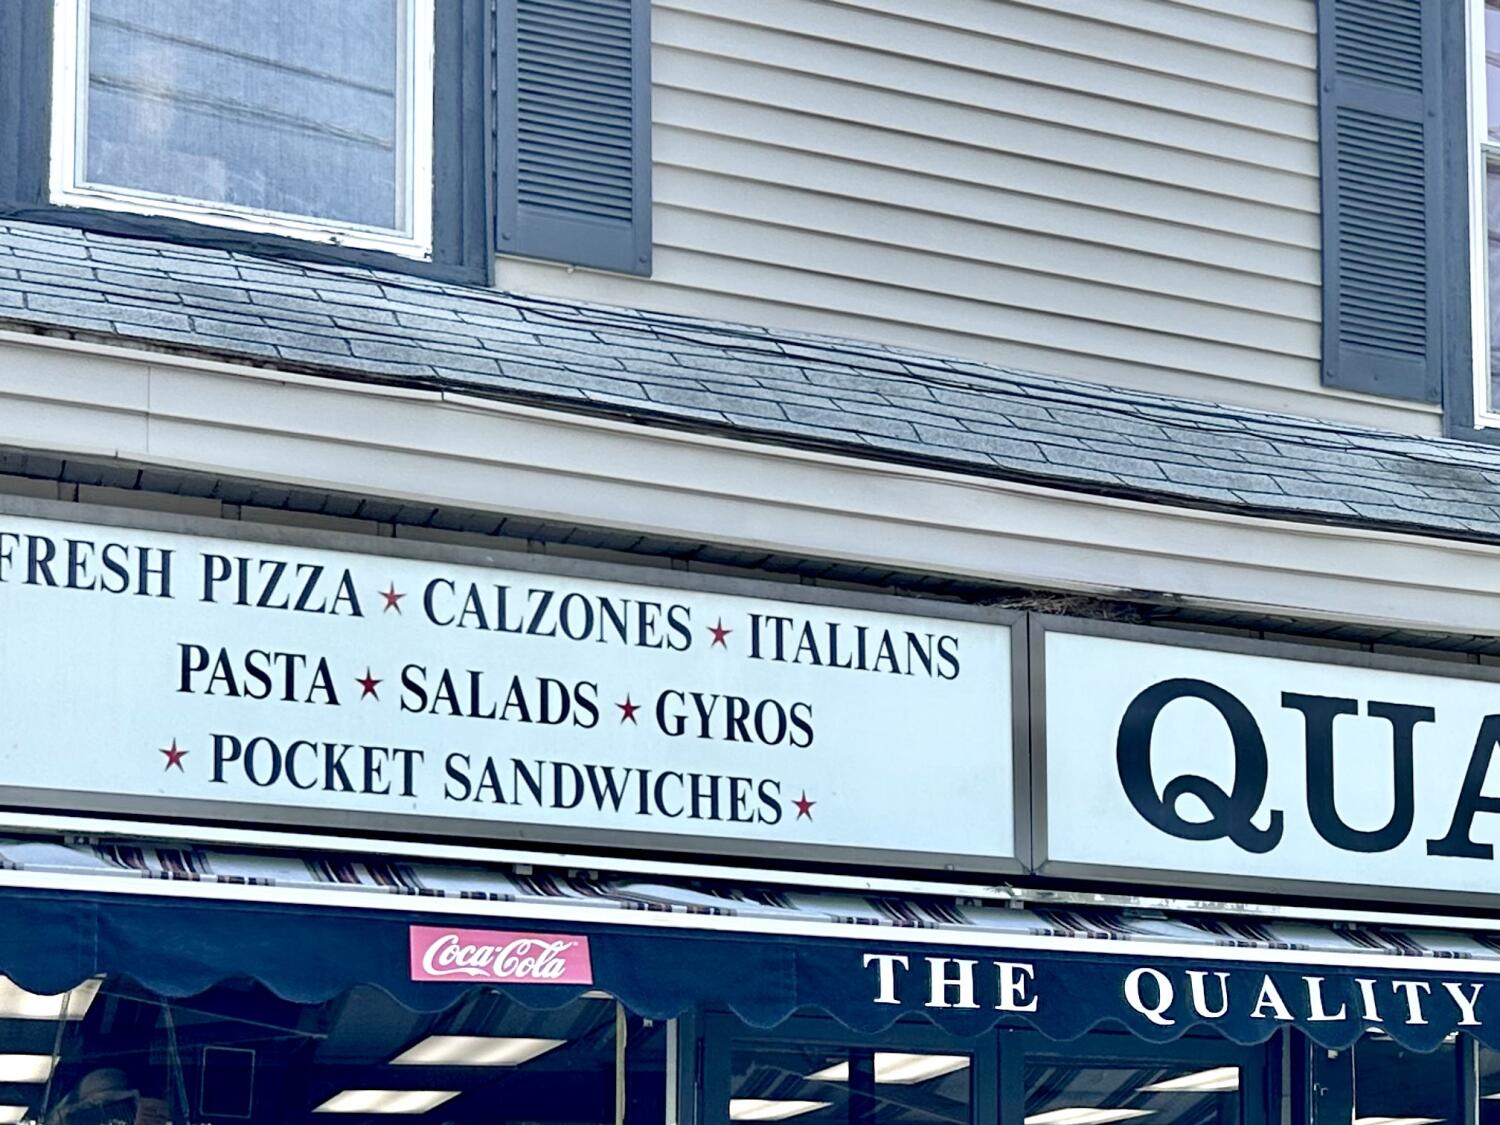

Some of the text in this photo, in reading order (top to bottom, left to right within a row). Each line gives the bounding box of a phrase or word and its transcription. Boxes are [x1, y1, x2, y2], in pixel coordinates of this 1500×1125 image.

[0, 531, 960, 681] FRESH PIZZA CALZONES ITALIANS
[177, 643, 815, 749] PASTA SALADS GYROS
[209, 733, 783, 826] POCKET SANDWICHES
[422, 934, 579, 980] Coca-Cola
[863, 953, 1039, 1012] THE
[1124, 967, 1484, 1026] QUALITY
